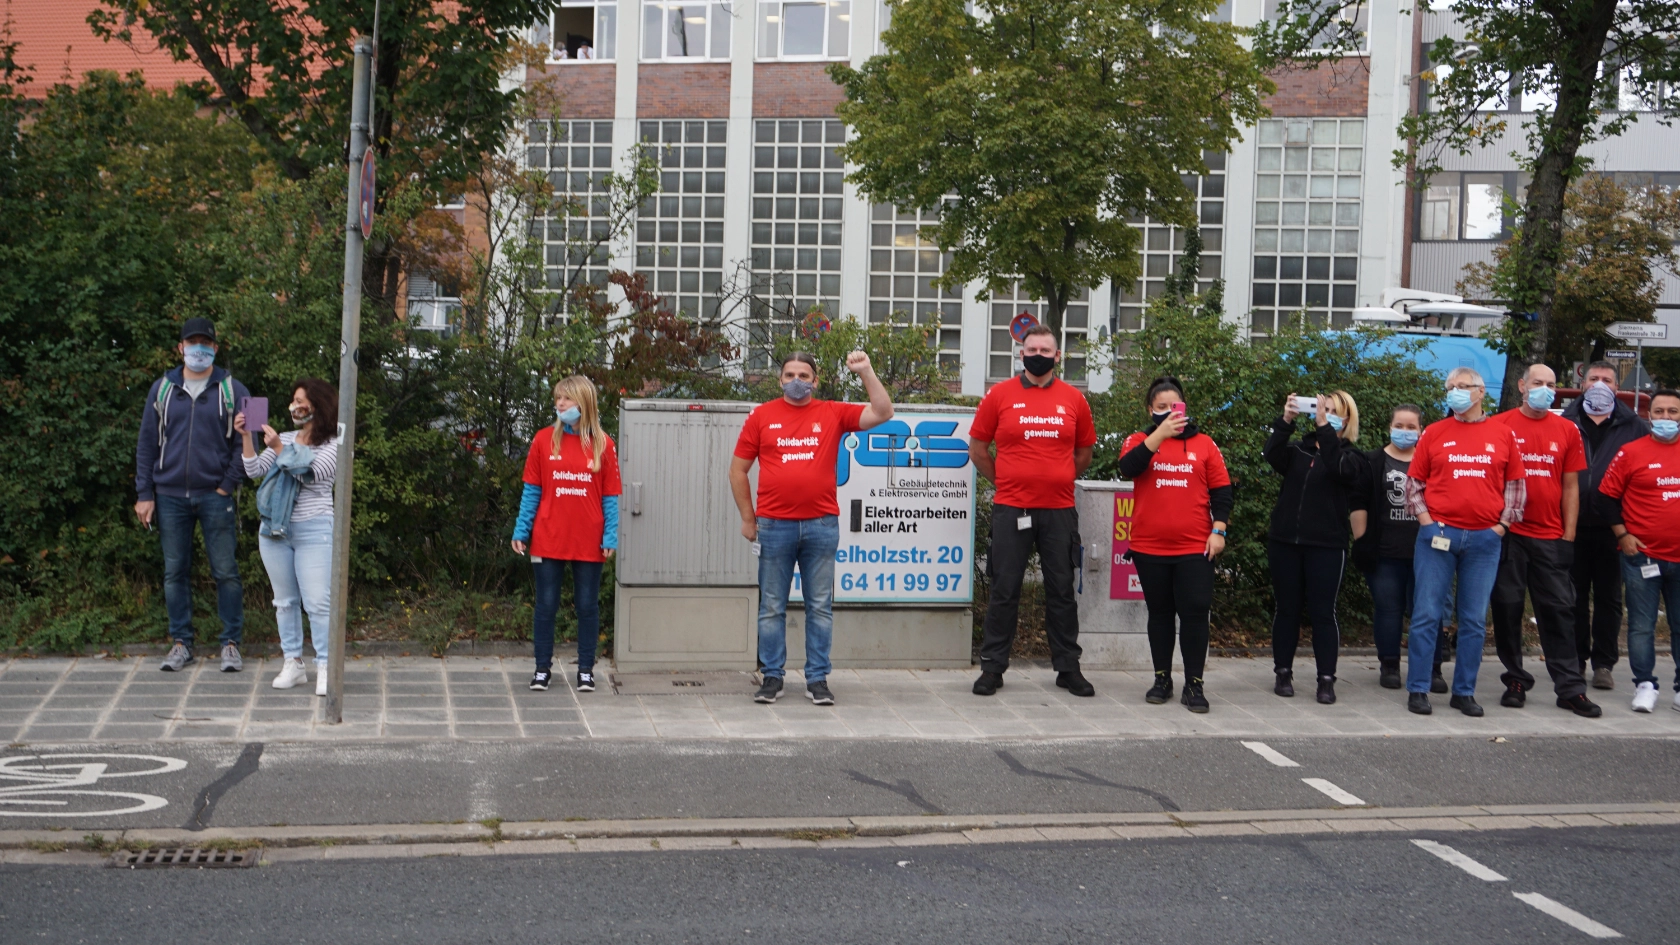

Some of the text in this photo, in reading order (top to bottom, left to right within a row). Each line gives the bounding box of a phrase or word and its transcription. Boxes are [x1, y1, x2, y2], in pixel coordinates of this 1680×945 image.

[1019, 415, 1064, 425] Solidarität
[1024, 429, 1059, 440] gewinnt
[776, 436, 819, 447] Solidarität
[781, 450, 814, 463] gewinnt
[1448, 453, 1492, 465] Solidarität
[1153, 461, 1193, 473] Solidarität
[552, 470, 592, 482] Solidarität
[1453, 468, 1486, 479] gewinnt
[899, 479, 967, 488] Gebäudetechnik
[1155, 477, 1188, 488] gewinnt
[555, 486, 587, 497] gewinnt
[869, 489, 968, 498] & Elektroservice GmbH
[865, 506, 967, 519] Elektroarbeiten
[864, 521, 918, 533] aller Art
[835, 545, 963, 564] elholzstr. 20
[841, 573, 963, 591] 64 11 99 97
